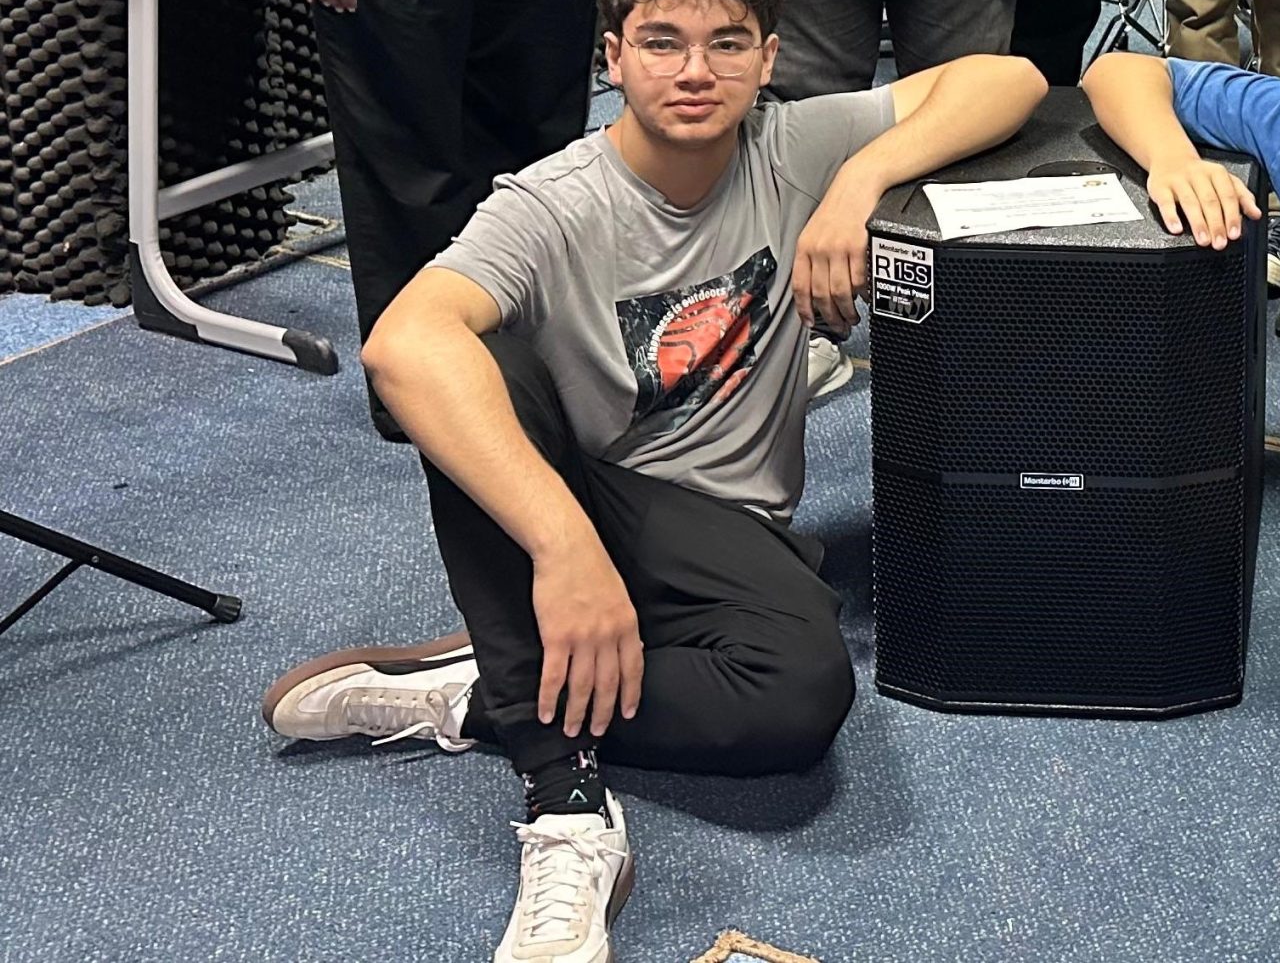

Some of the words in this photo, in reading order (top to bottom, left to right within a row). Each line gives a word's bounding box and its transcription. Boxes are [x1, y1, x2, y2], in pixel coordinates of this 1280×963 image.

[647, 311, 675, 361] Happiness
[671, 303, 683, 314] is
[681, 287, 727, 307] outdoors
[1023, 476, 1062, 486] Montarbo
